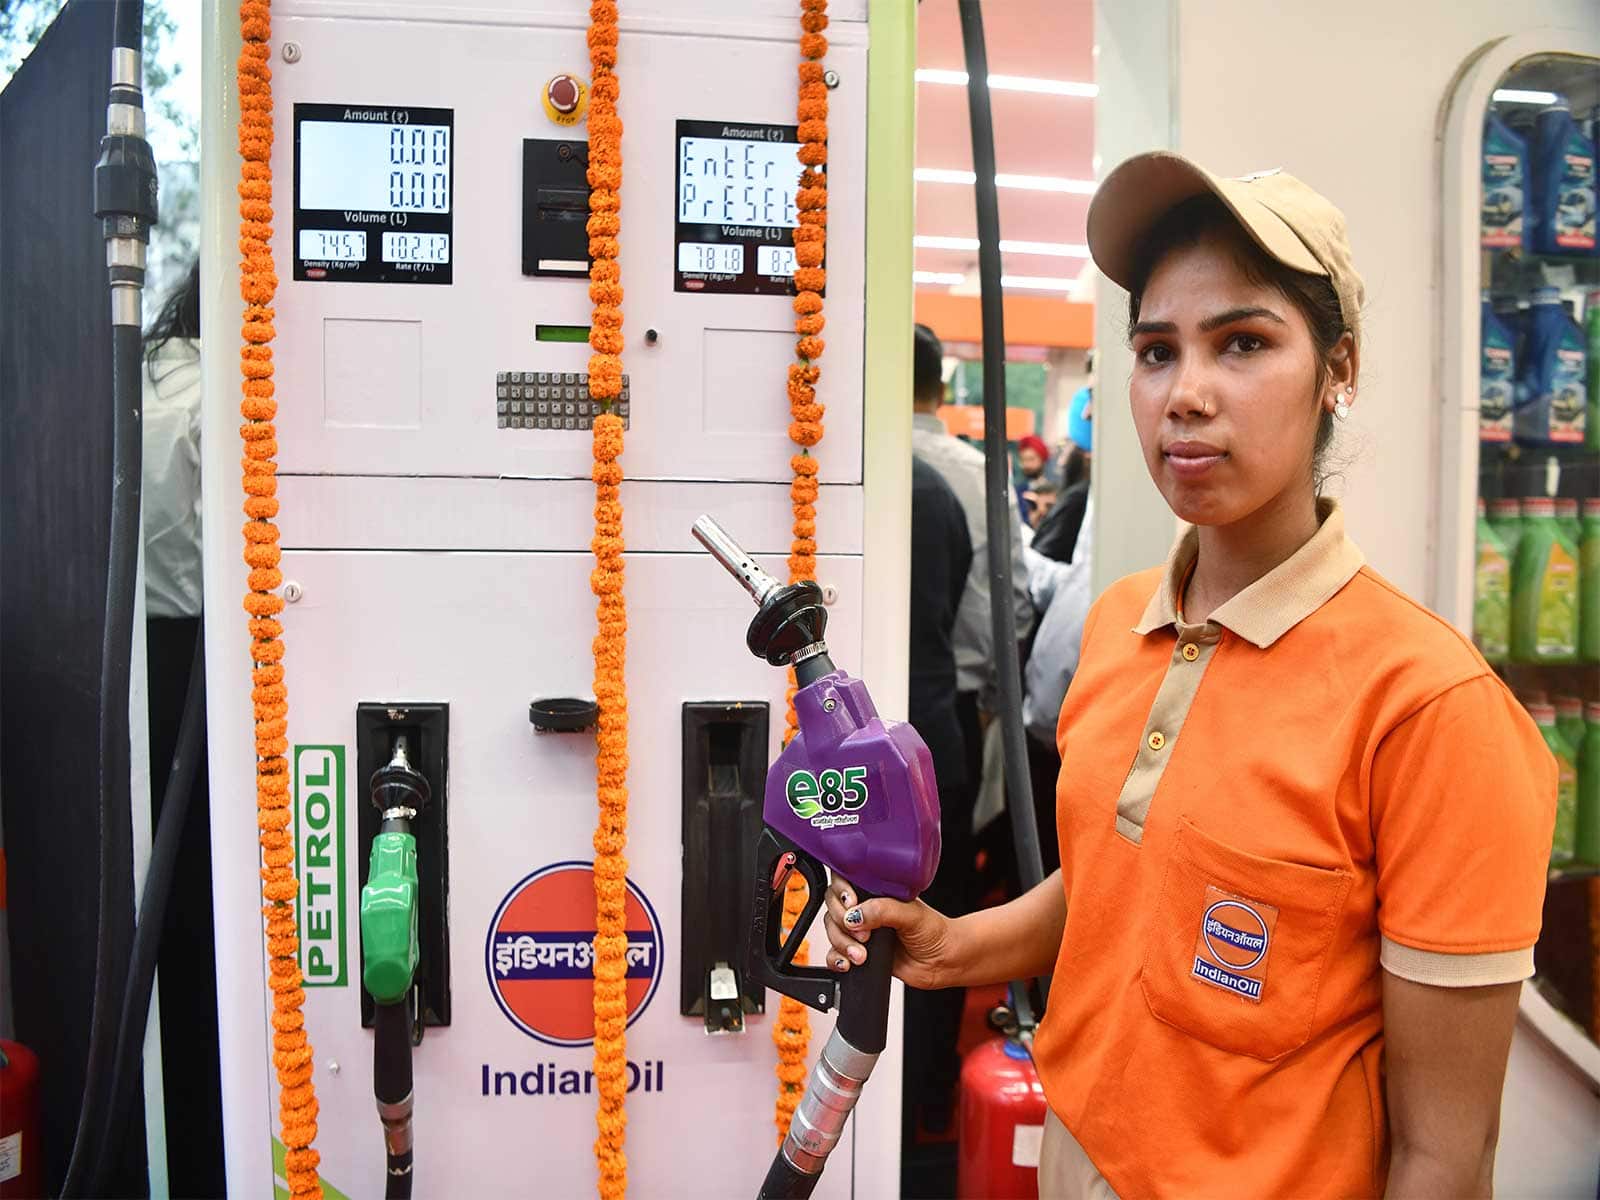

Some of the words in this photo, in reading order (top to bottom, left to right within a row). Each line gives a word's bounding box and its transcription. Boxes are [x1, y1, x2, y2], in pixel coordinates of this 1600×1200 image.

[343, 109, 388, 122] Amount
[722, 127, 764, 139] Amount
[390, 128, 446, 166] 0.00
[390, 171, 446, 209] 0.00
[344, 211, 387, 224] Volume
[390, 212, 408, 226] (L)
[722, 225, 762, 238] Volume
[765, 226, 782, 240] (L)
[391, 235, 446, 261] 102.12
[696, 246, 740, 271] 781.8
[786, 767, 868, 818] e85
[305, 757, 332, 976] PETROL
[1196, 960, 1259, 995] IndianOil
